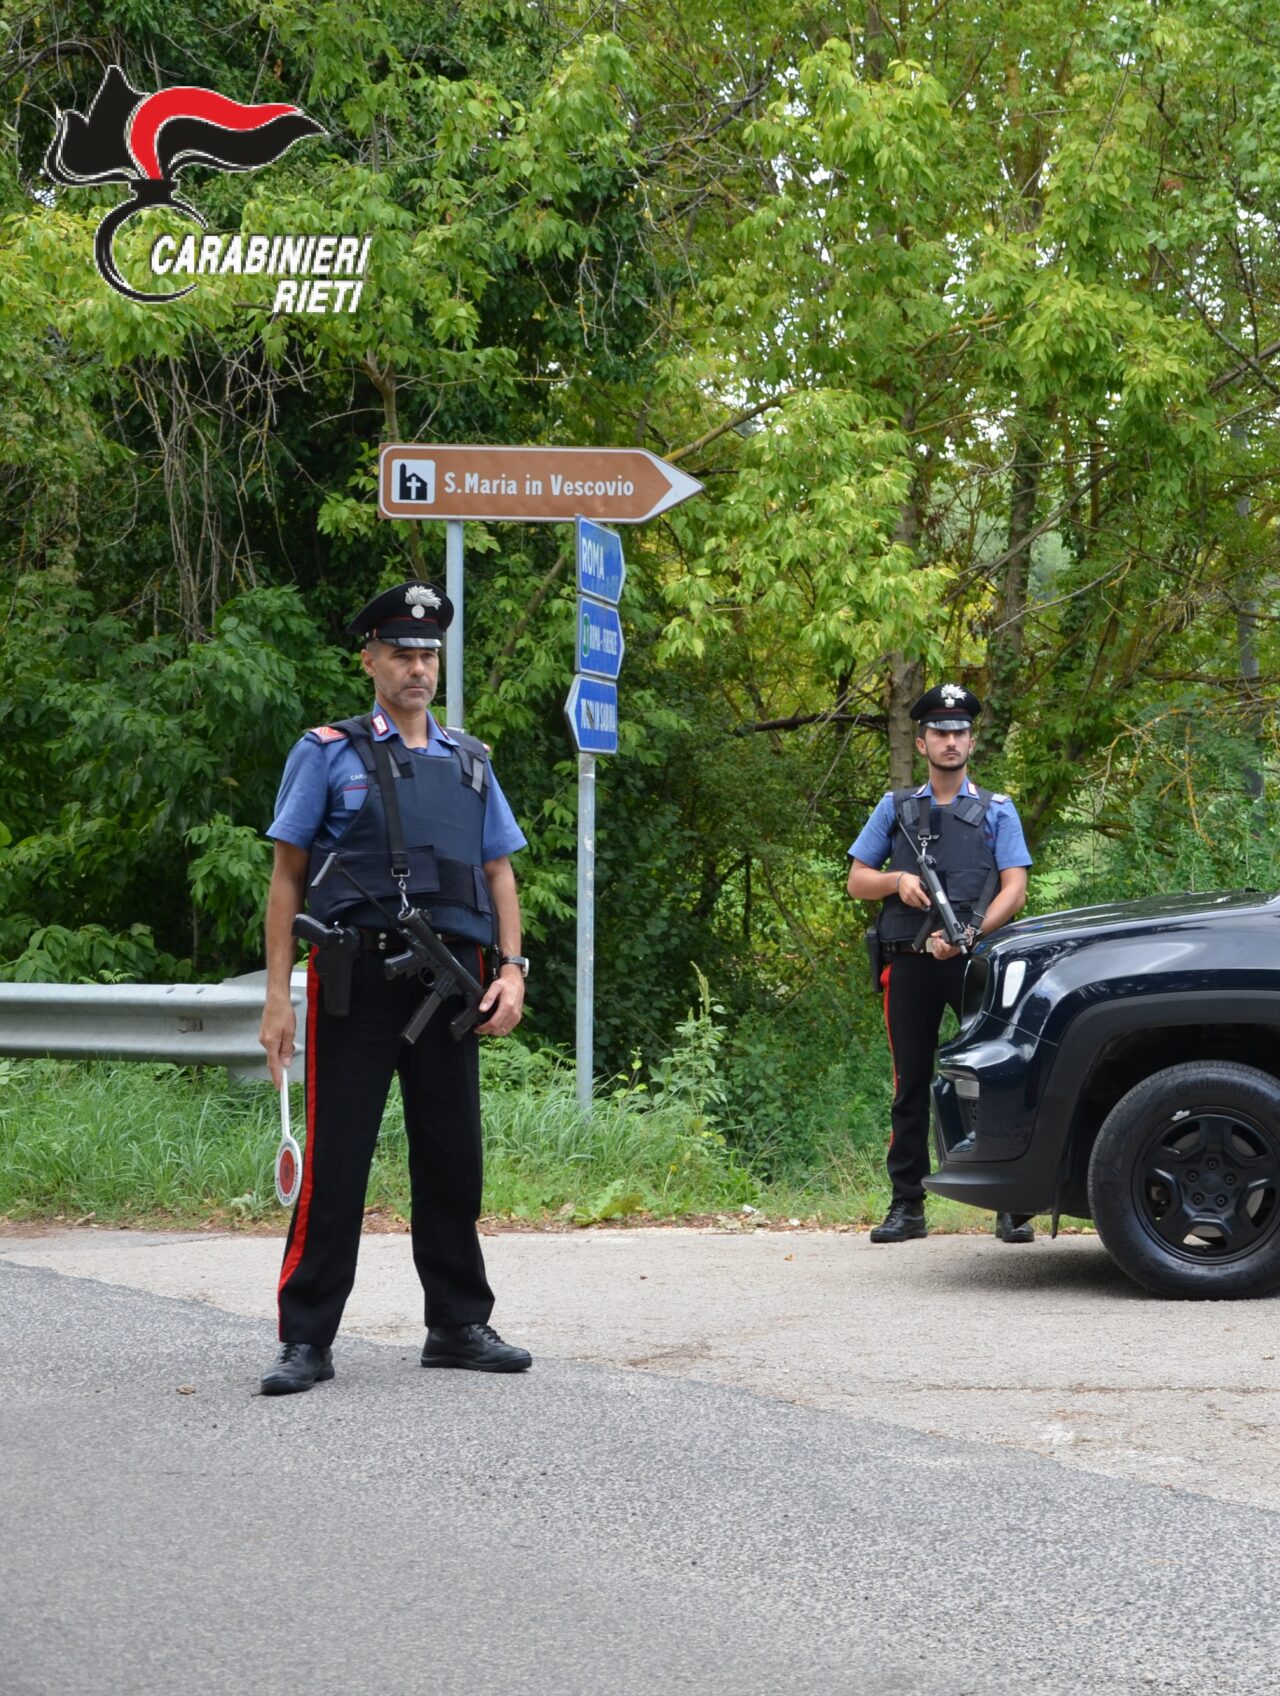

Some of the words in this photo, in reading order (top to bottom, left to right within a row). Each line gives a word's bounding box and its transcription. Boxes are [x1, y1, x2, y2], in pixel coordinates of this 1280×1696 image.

[444, 472, 517, 496] S.Maria
[525, 474, 542, 496] in
[550, 474, 634, 497] Vescovio
[581, 537, 605, 581] ROMA
